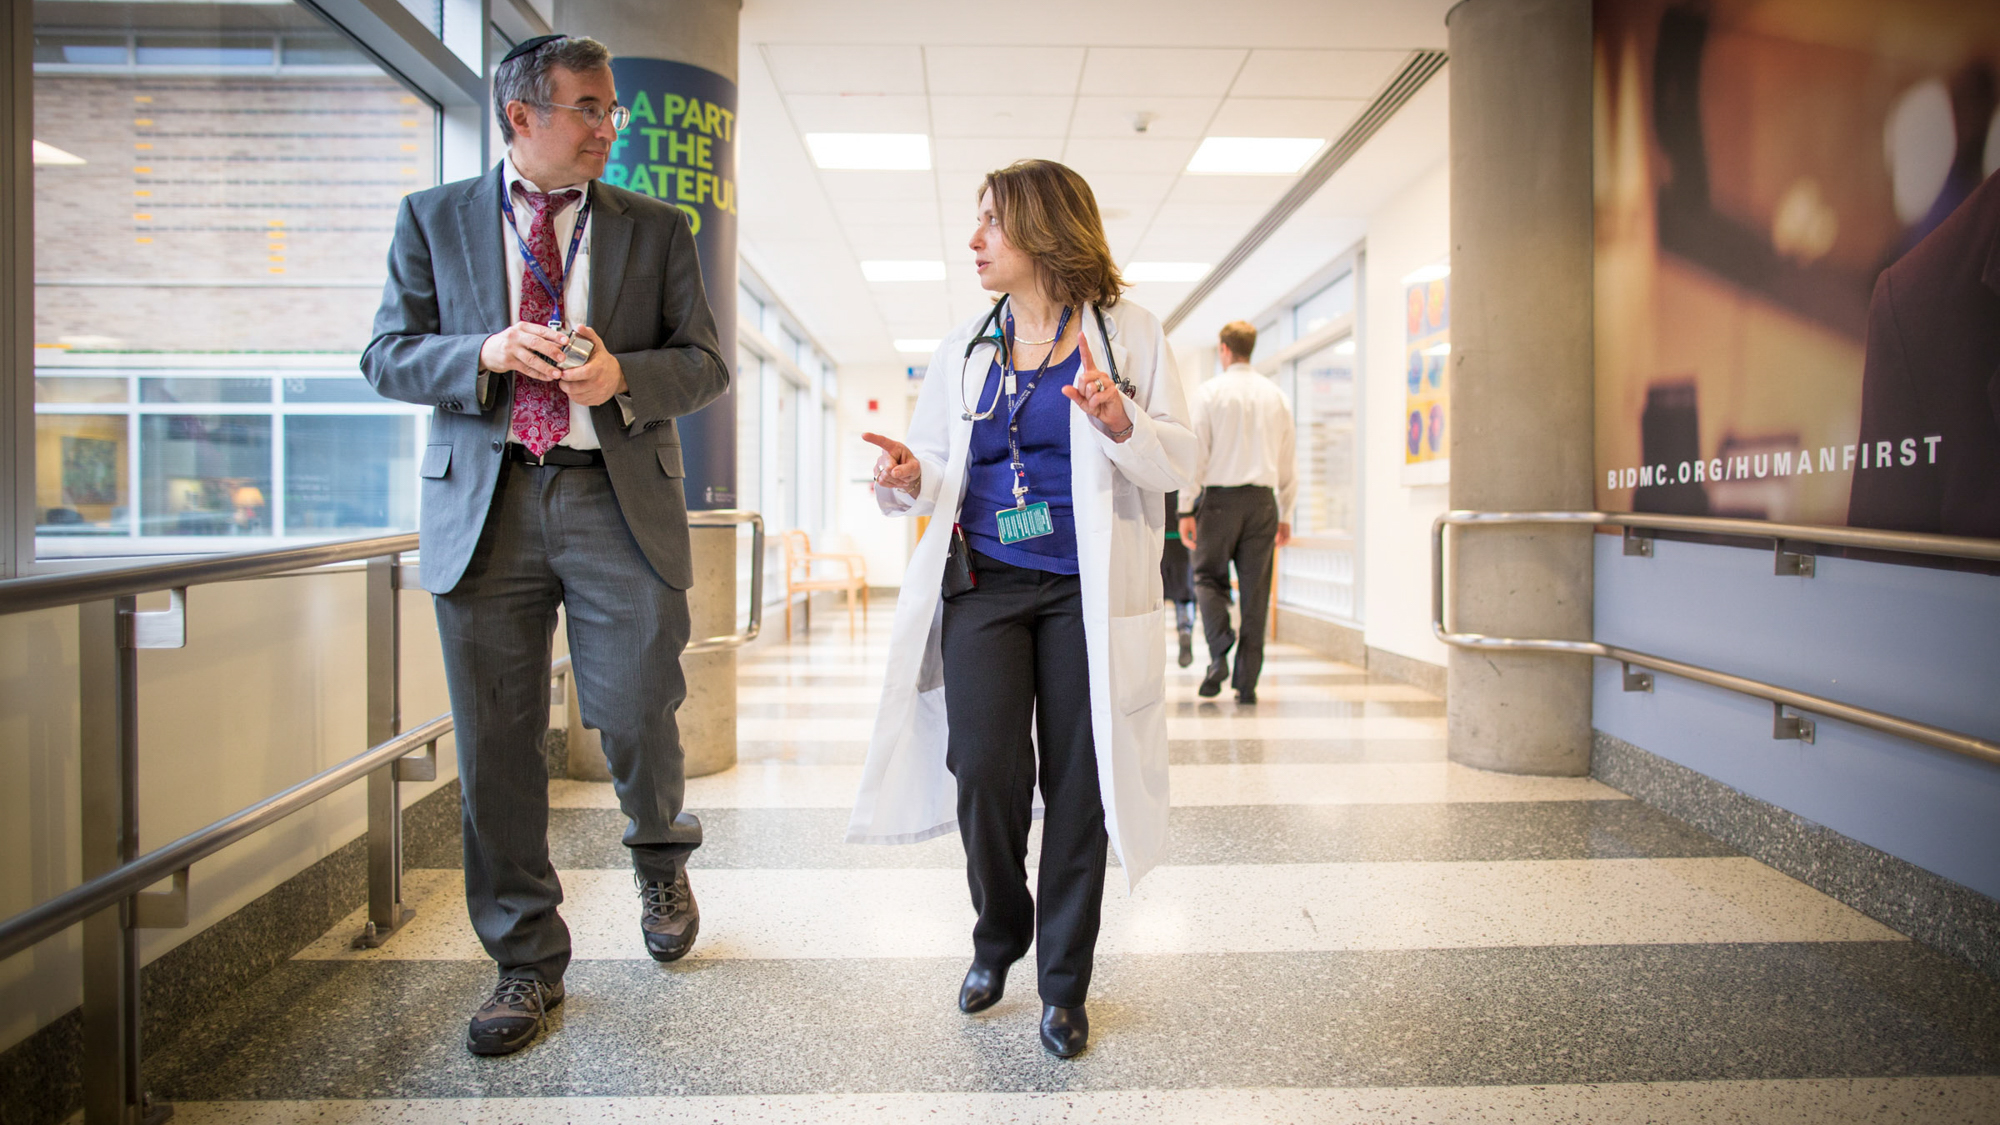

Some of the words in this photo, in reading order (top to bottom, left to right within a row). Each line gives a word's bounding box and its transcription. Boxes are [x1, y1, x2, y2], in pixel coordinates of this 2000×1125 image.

[630, 90, 657, 125] A
[664, 93, 734, 142] PART
[640, 128, 713, 170] THE
[598, 163, 736, 216] RATEFUL
[1607, 435, 1942, 490] BIDMC.ORG/HUMANFIRST
